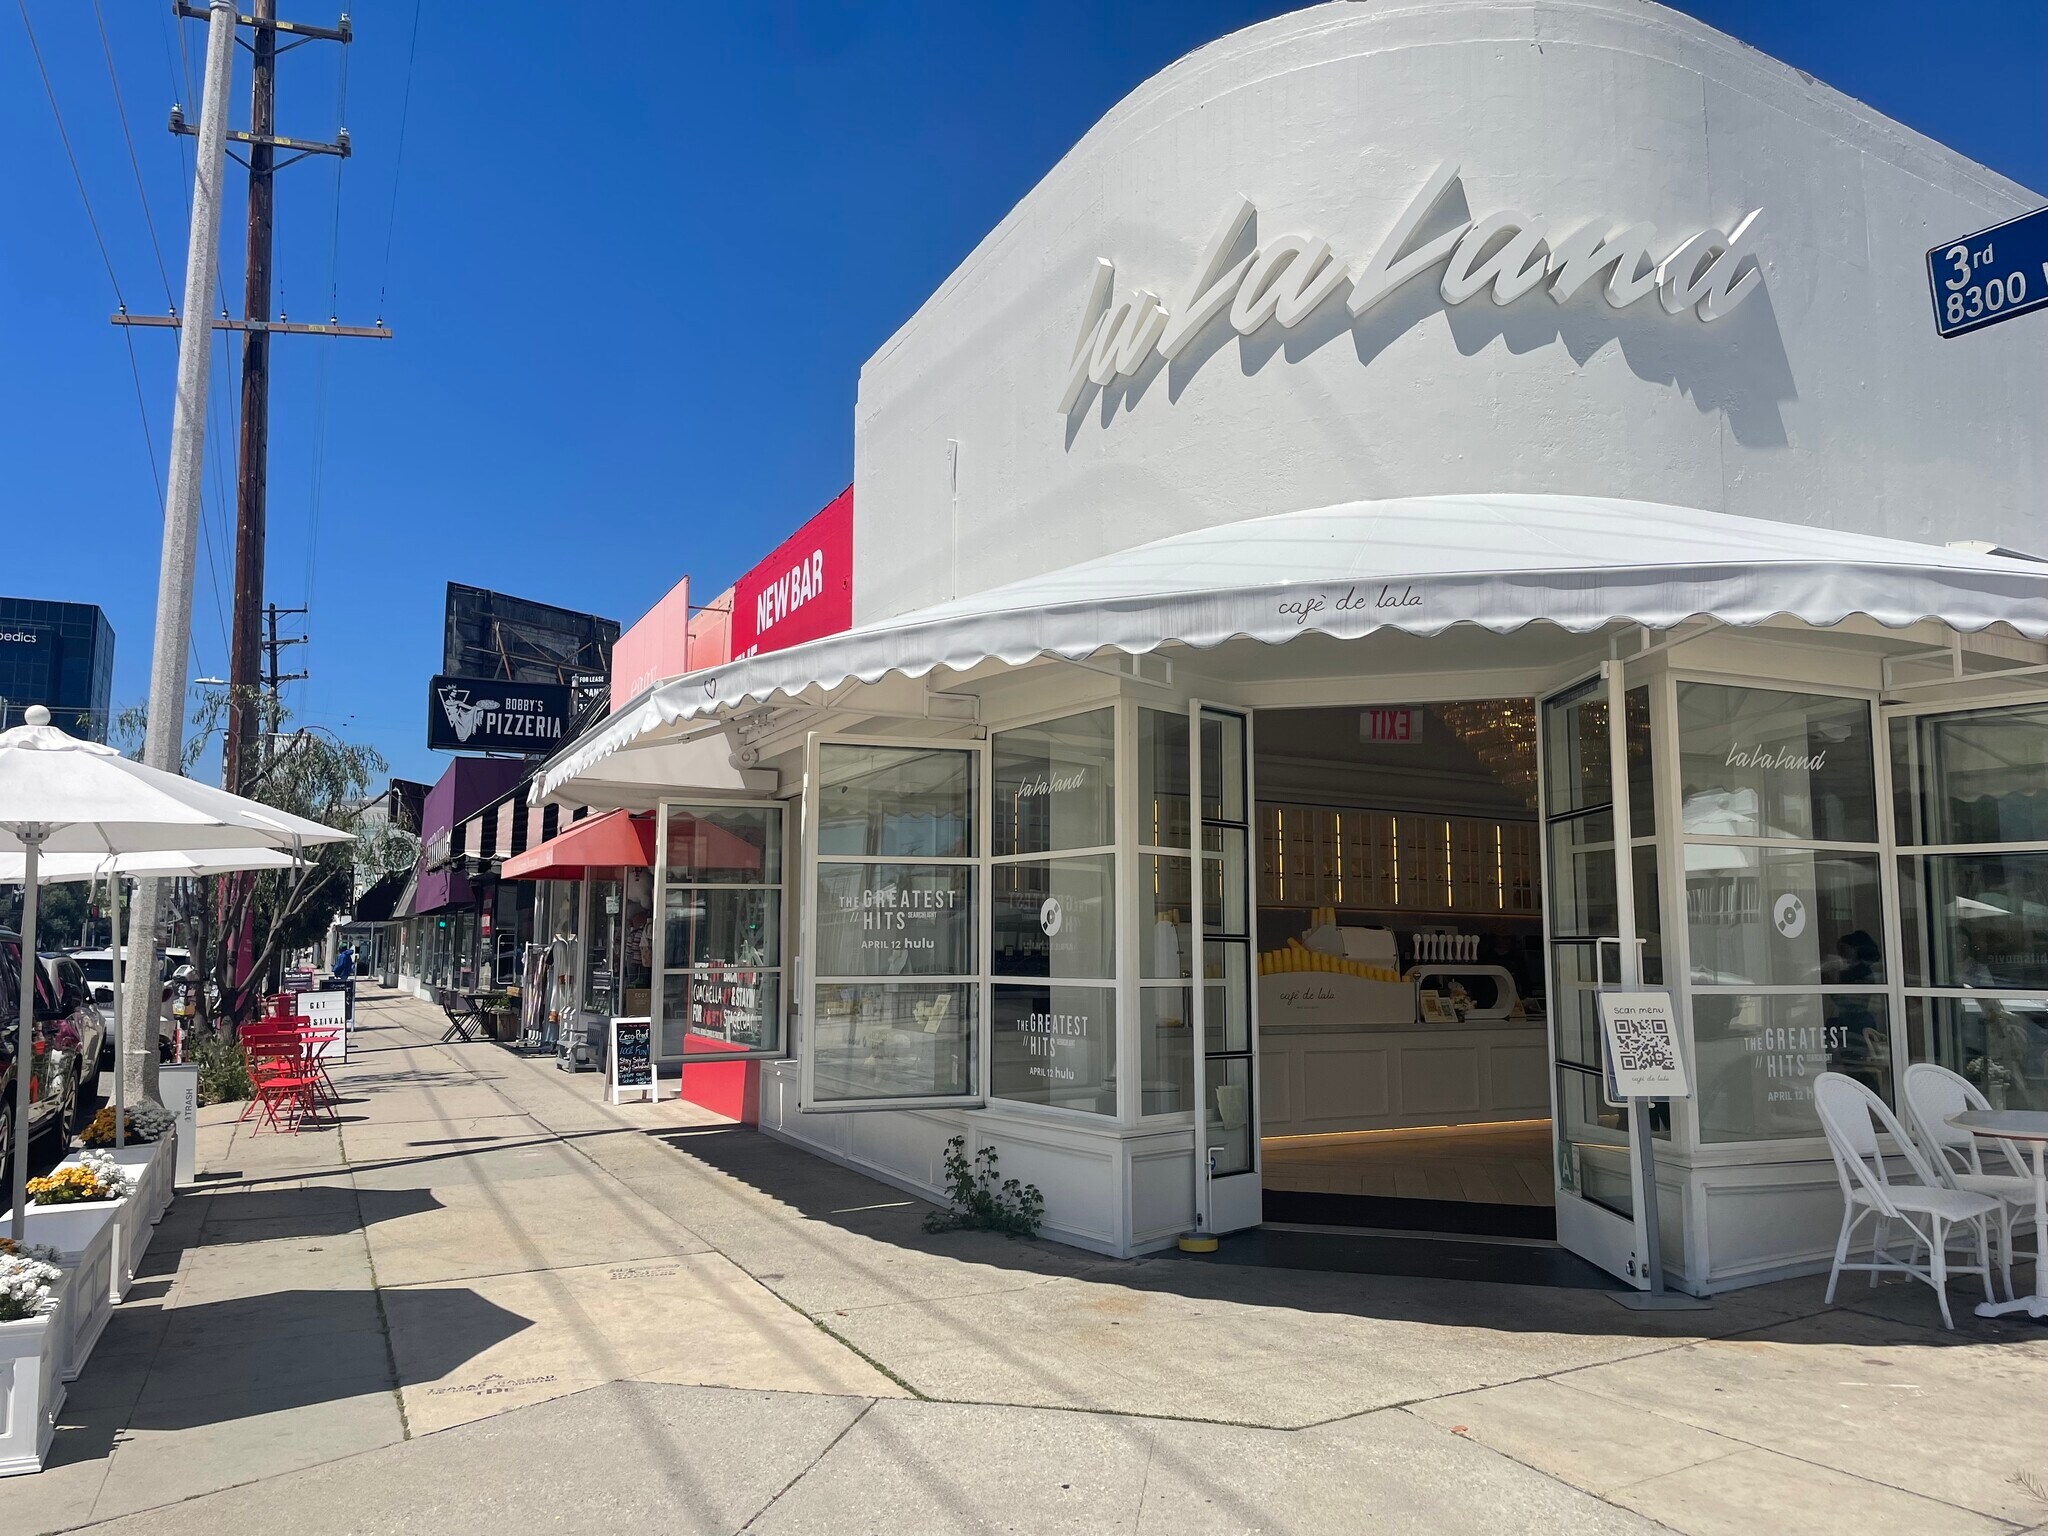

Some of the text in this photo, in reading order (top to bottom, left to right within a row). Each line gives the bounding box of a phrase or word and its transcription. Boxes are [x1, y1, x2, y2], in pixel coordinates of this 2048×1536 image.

[1945, 243, 1994, 290] 3rd
[1947, 271, 2026, 324] 8300
[1336, 586, 1366, 610] de
[1375, 585, 1423, 608] lala
[590, 675, 604, 683] LEASE
[506, 698, 544, 712] BOBBY'S
[486, 713, 562, 738] PIZZERIA
[839, 889, 956, 909] THE GREATEST
[863, 911, 906, 930] HITS
[861, 937, 935, 949] APRIL 12 hulu
[693, 984, 722, 1004] COACHELLA
[1302, 987, 1314, 1000] de
[1317, 986, 1336, 1000] lala
[309, 1001, 326, 1010] GET
[692, 1003, 702, 1023] FOR
[1614, 1007, 1664, 1015] scan menu
[1017, 1012, 1088, 1037] THE GREATEST
[1030, 1035, 1056, 1057] HITS
[1744, 1026, 1848, 1051] THE GREATEST
[1029, 1066, 1075, 1080] APRIL 12 hulu
[1767, 1055, 1805, 1078] HITS
[184, 1088, 193, 1115] TRASH
[1768, 1092, 1793, 1102] APRIL
